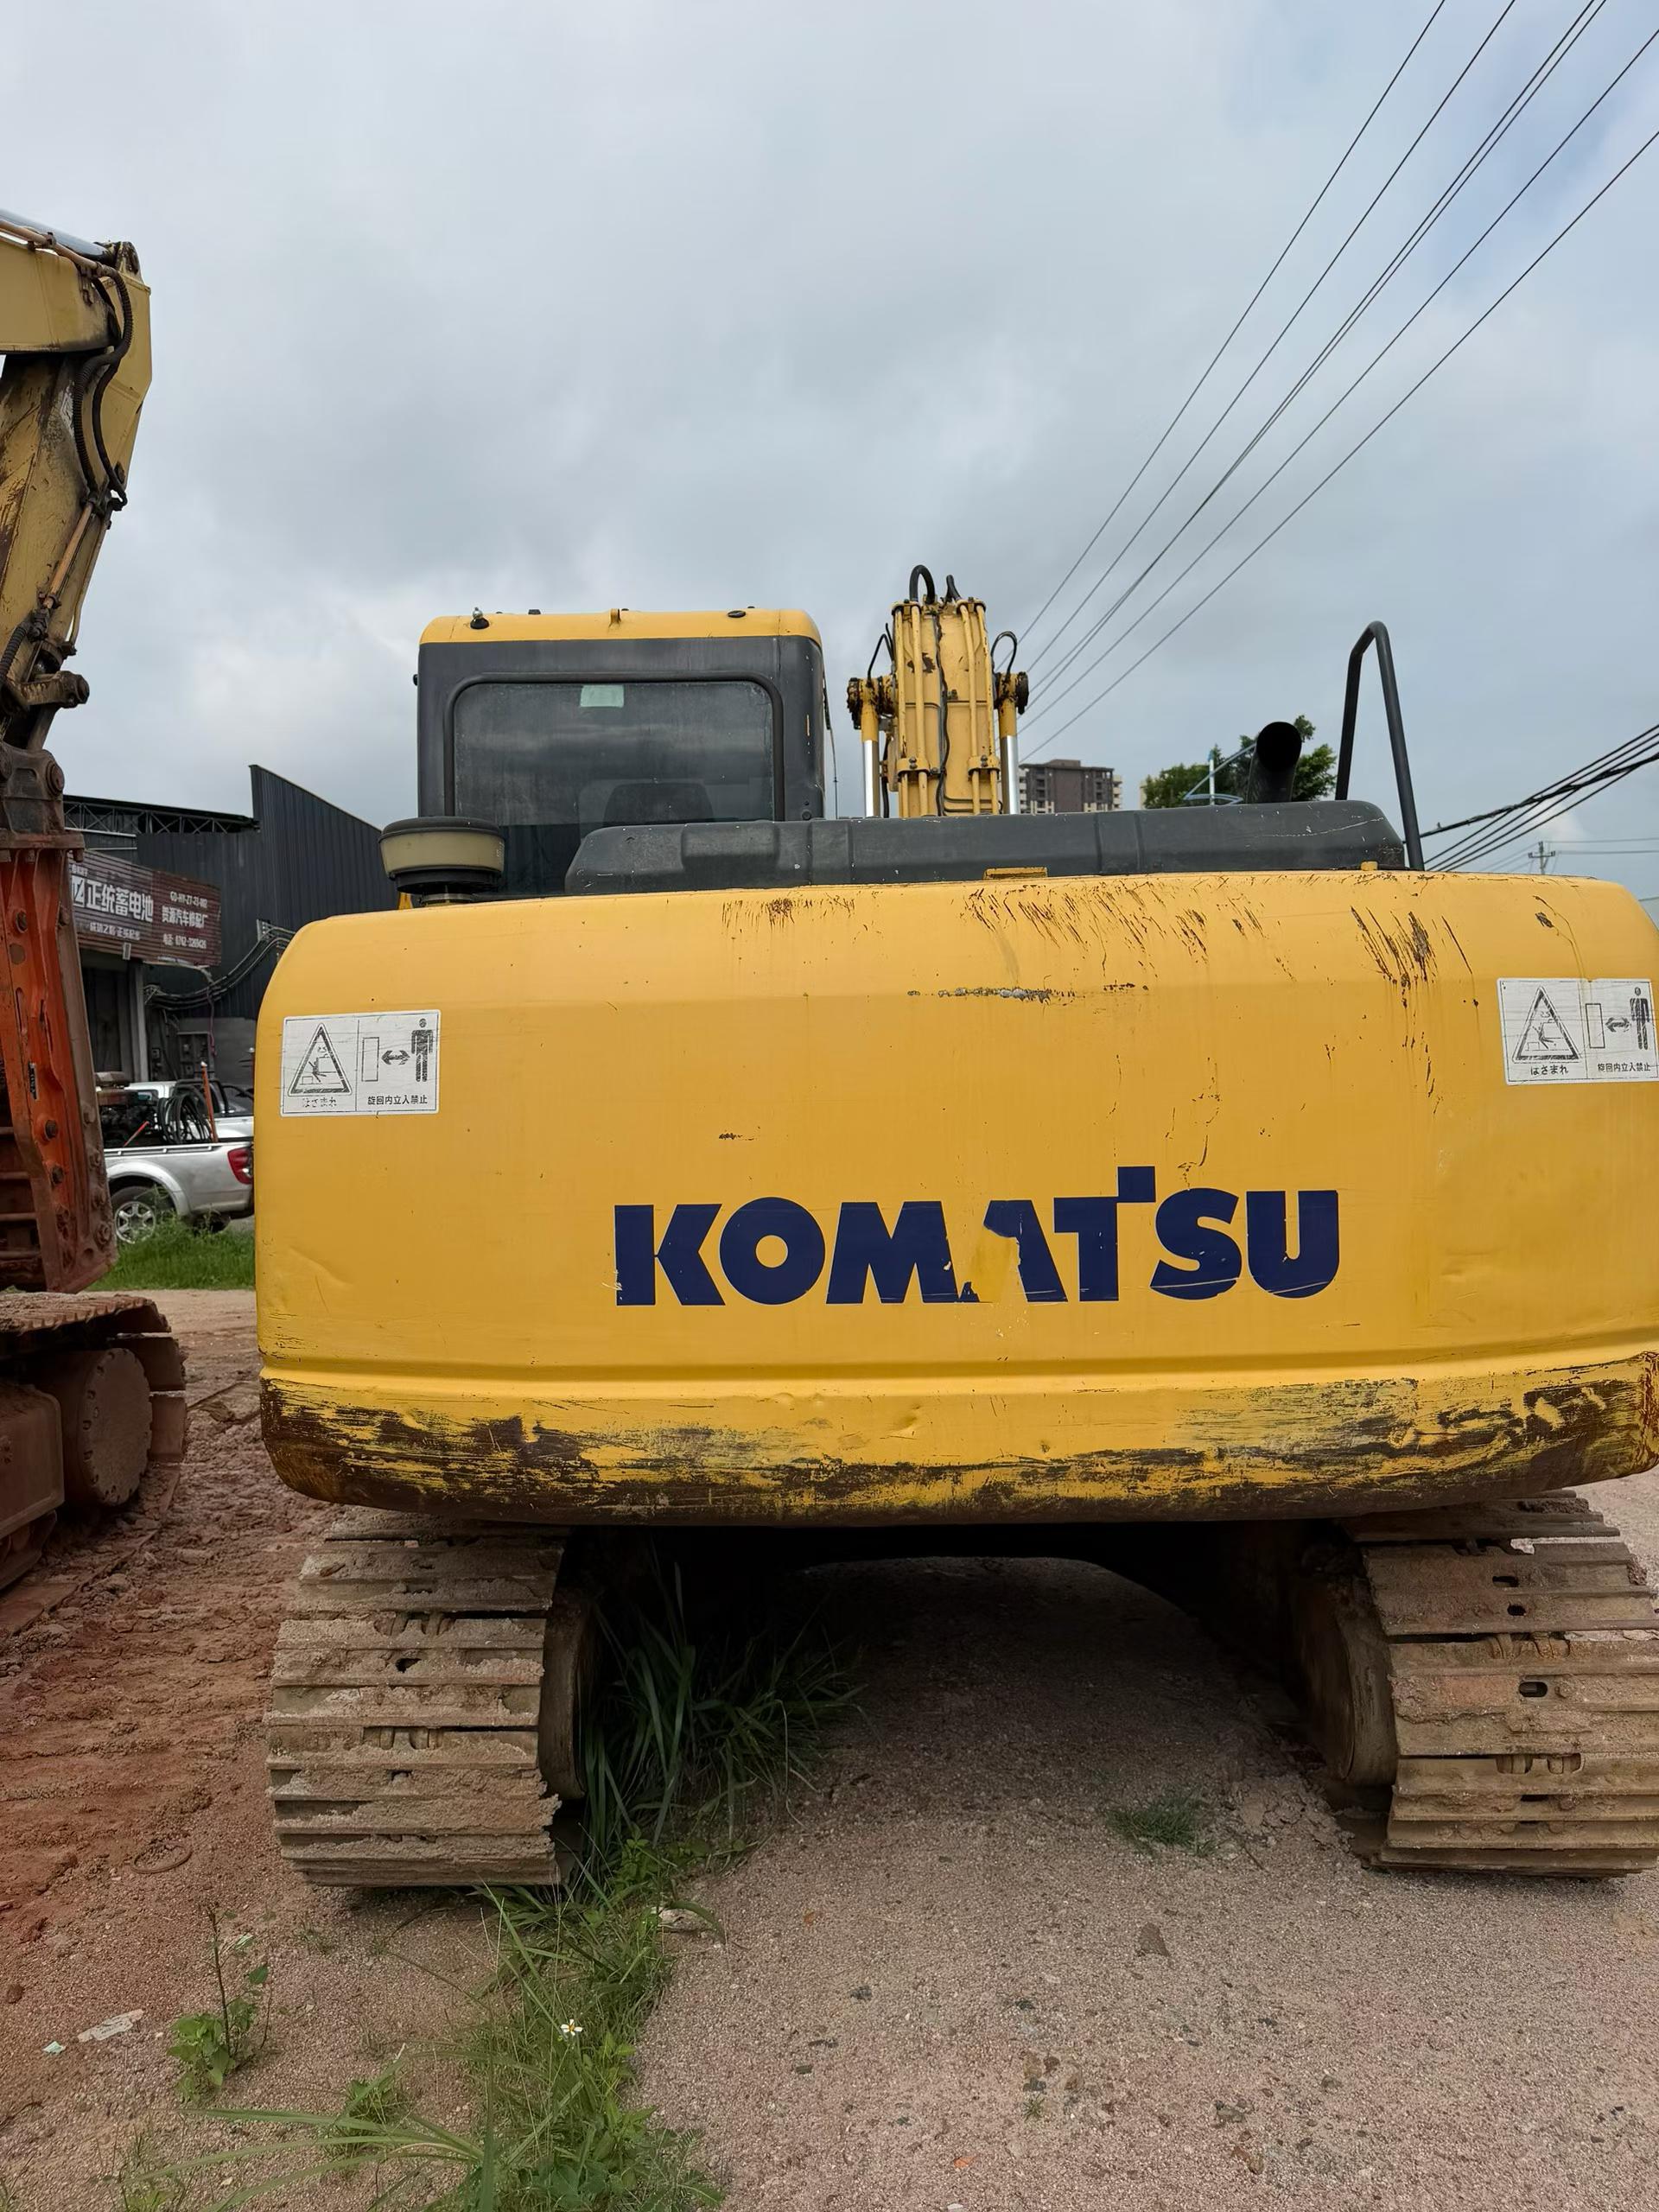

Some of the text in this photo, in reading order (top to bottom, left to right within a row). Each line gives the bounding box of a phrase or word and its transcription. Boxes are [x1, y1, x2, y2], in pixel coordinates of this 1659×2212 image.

[86, 879, 154, 922] 正统蓄电池
[1530, 1064, 1568, 1076] はさまれ
[1598, 1062, 1650, 1072] 旋回内立入禁止
[367, 1095, 428, 1105] 旋回内立入禁止
[614, 1166, 1339, 1306] KOMATSU
